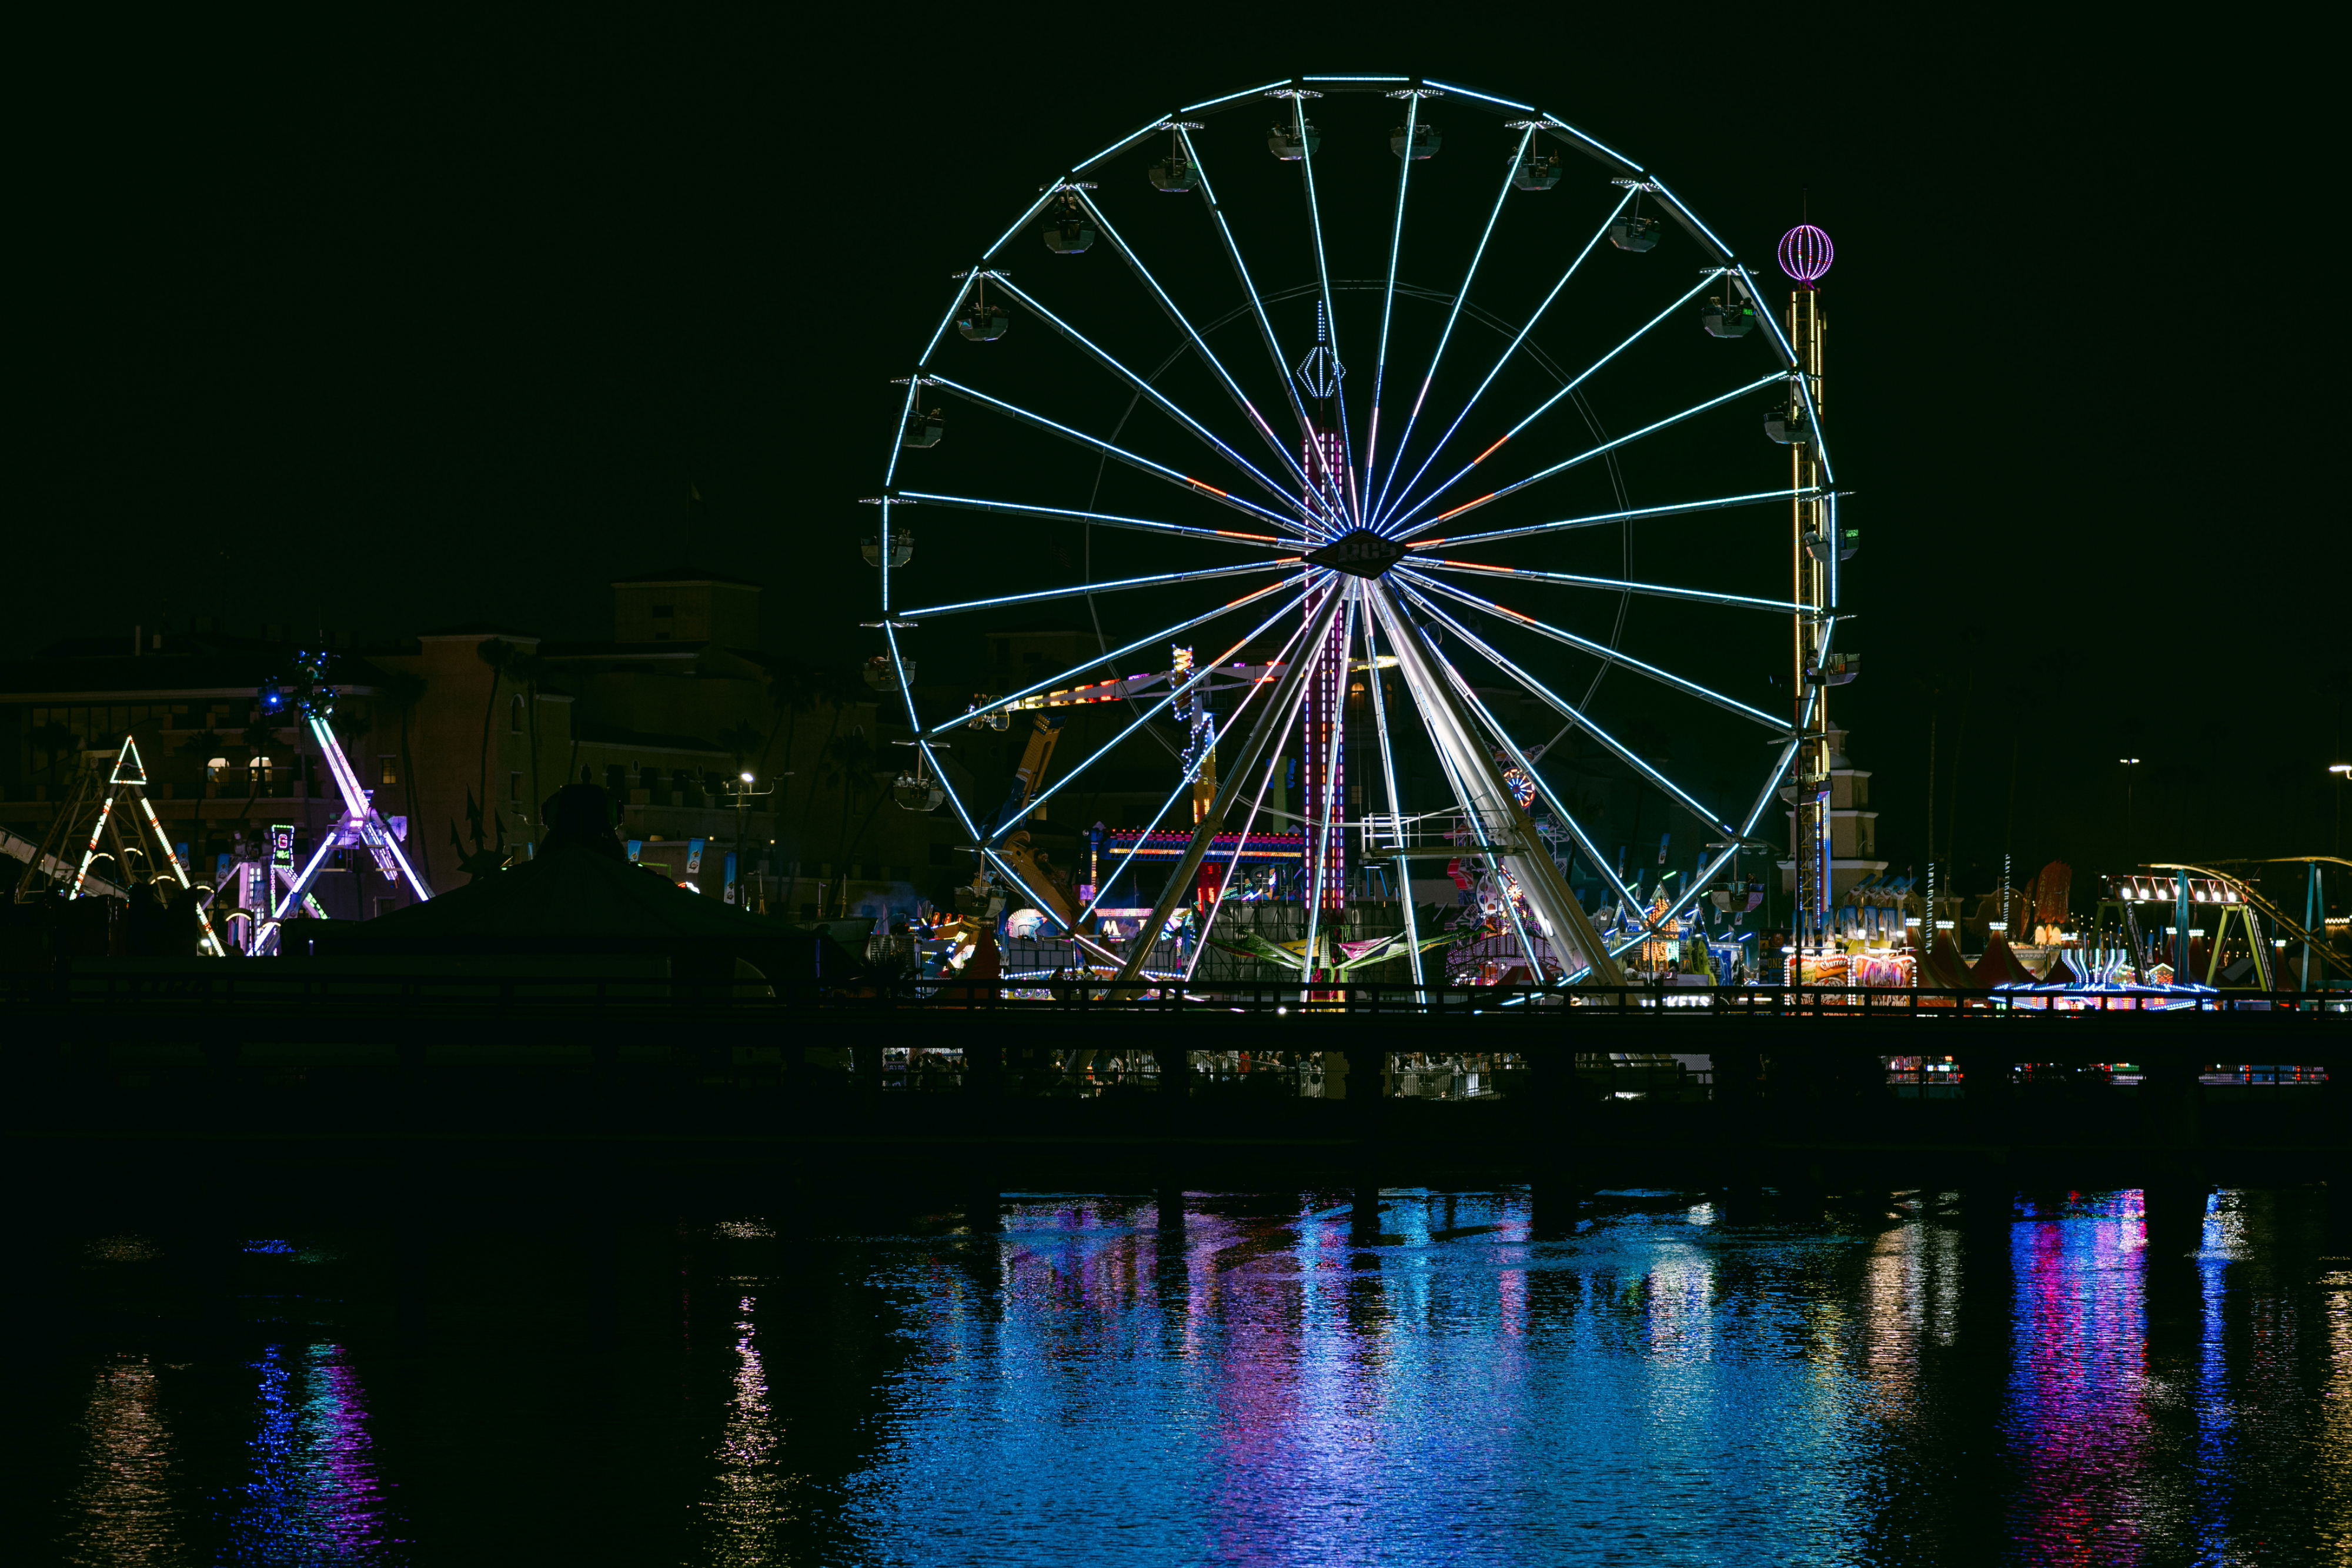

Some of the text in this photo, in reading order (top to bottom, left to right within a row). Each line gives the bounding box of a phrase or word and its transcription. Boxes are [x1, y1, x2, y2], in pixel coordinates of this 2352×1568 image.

[1338, 543, 1397, 563] RCS
[1768, 958, 1783, 969] ONE
[1820, 959, 1847, 971] Churros
